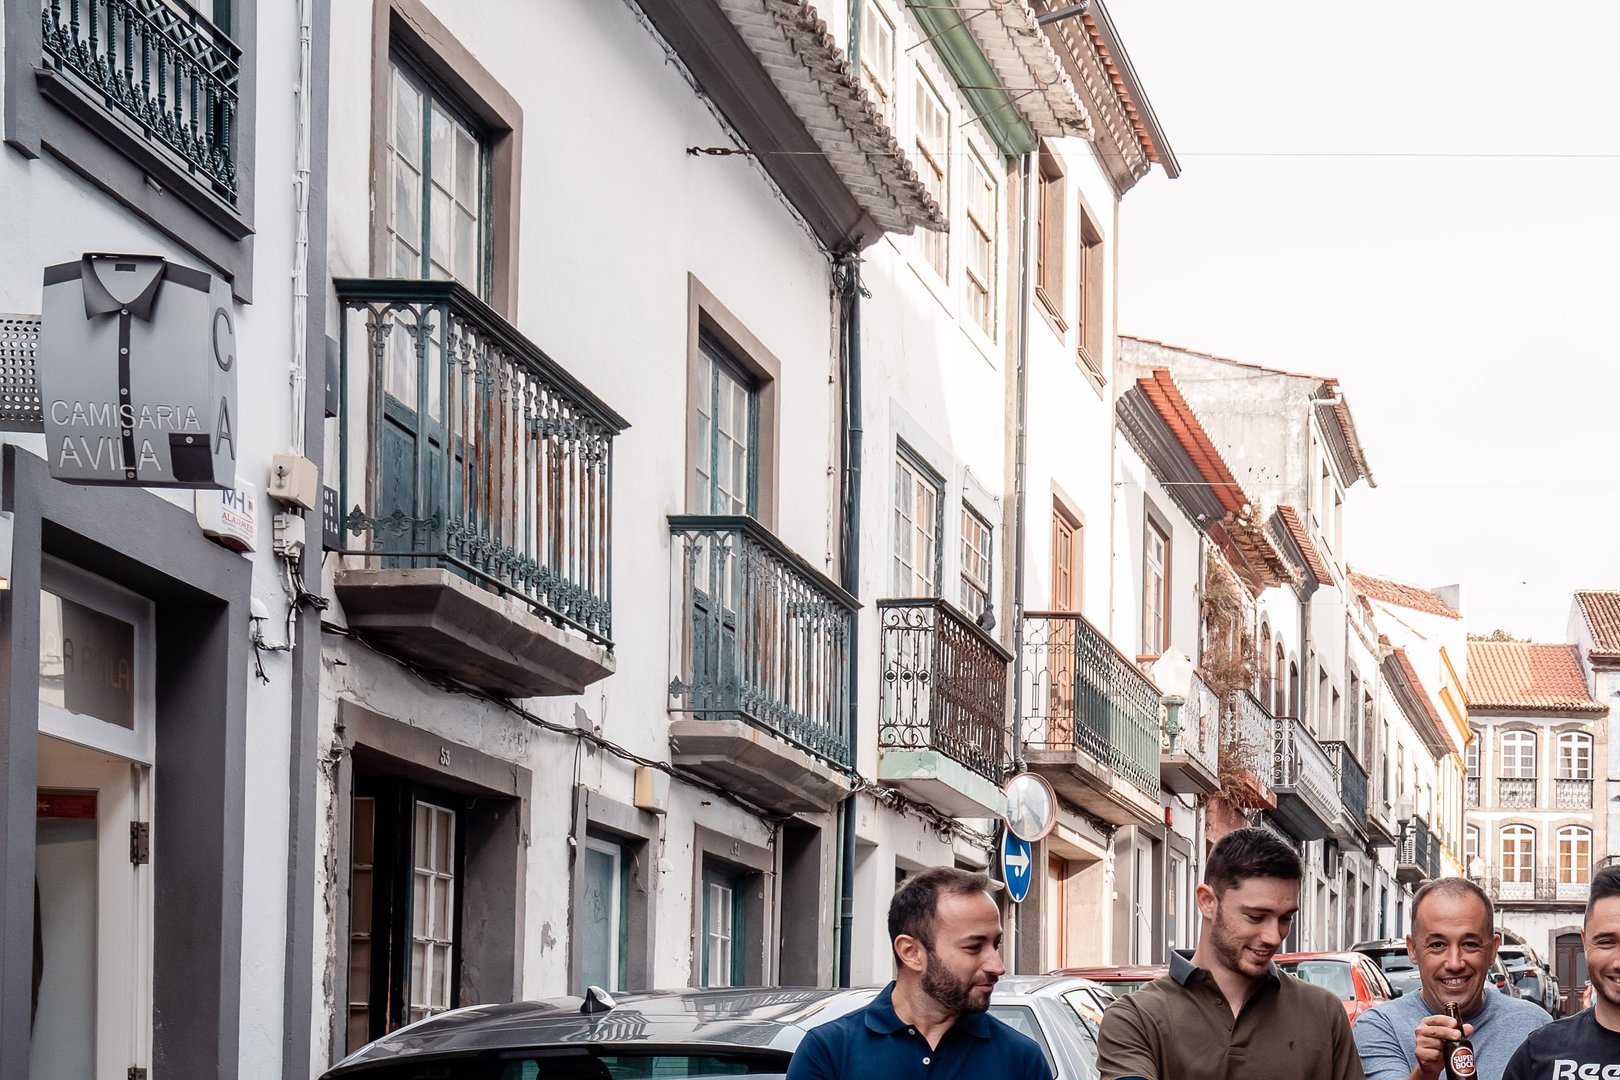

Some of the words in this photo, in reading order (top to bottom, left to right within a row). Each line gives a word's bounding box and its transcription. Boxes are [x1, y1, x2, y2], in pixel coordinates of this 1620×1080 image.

[50, 398, 202, 432] CAMISARIA
[58, 435, 163, 473] AVILA
[439, 745, 451, 766] 53
